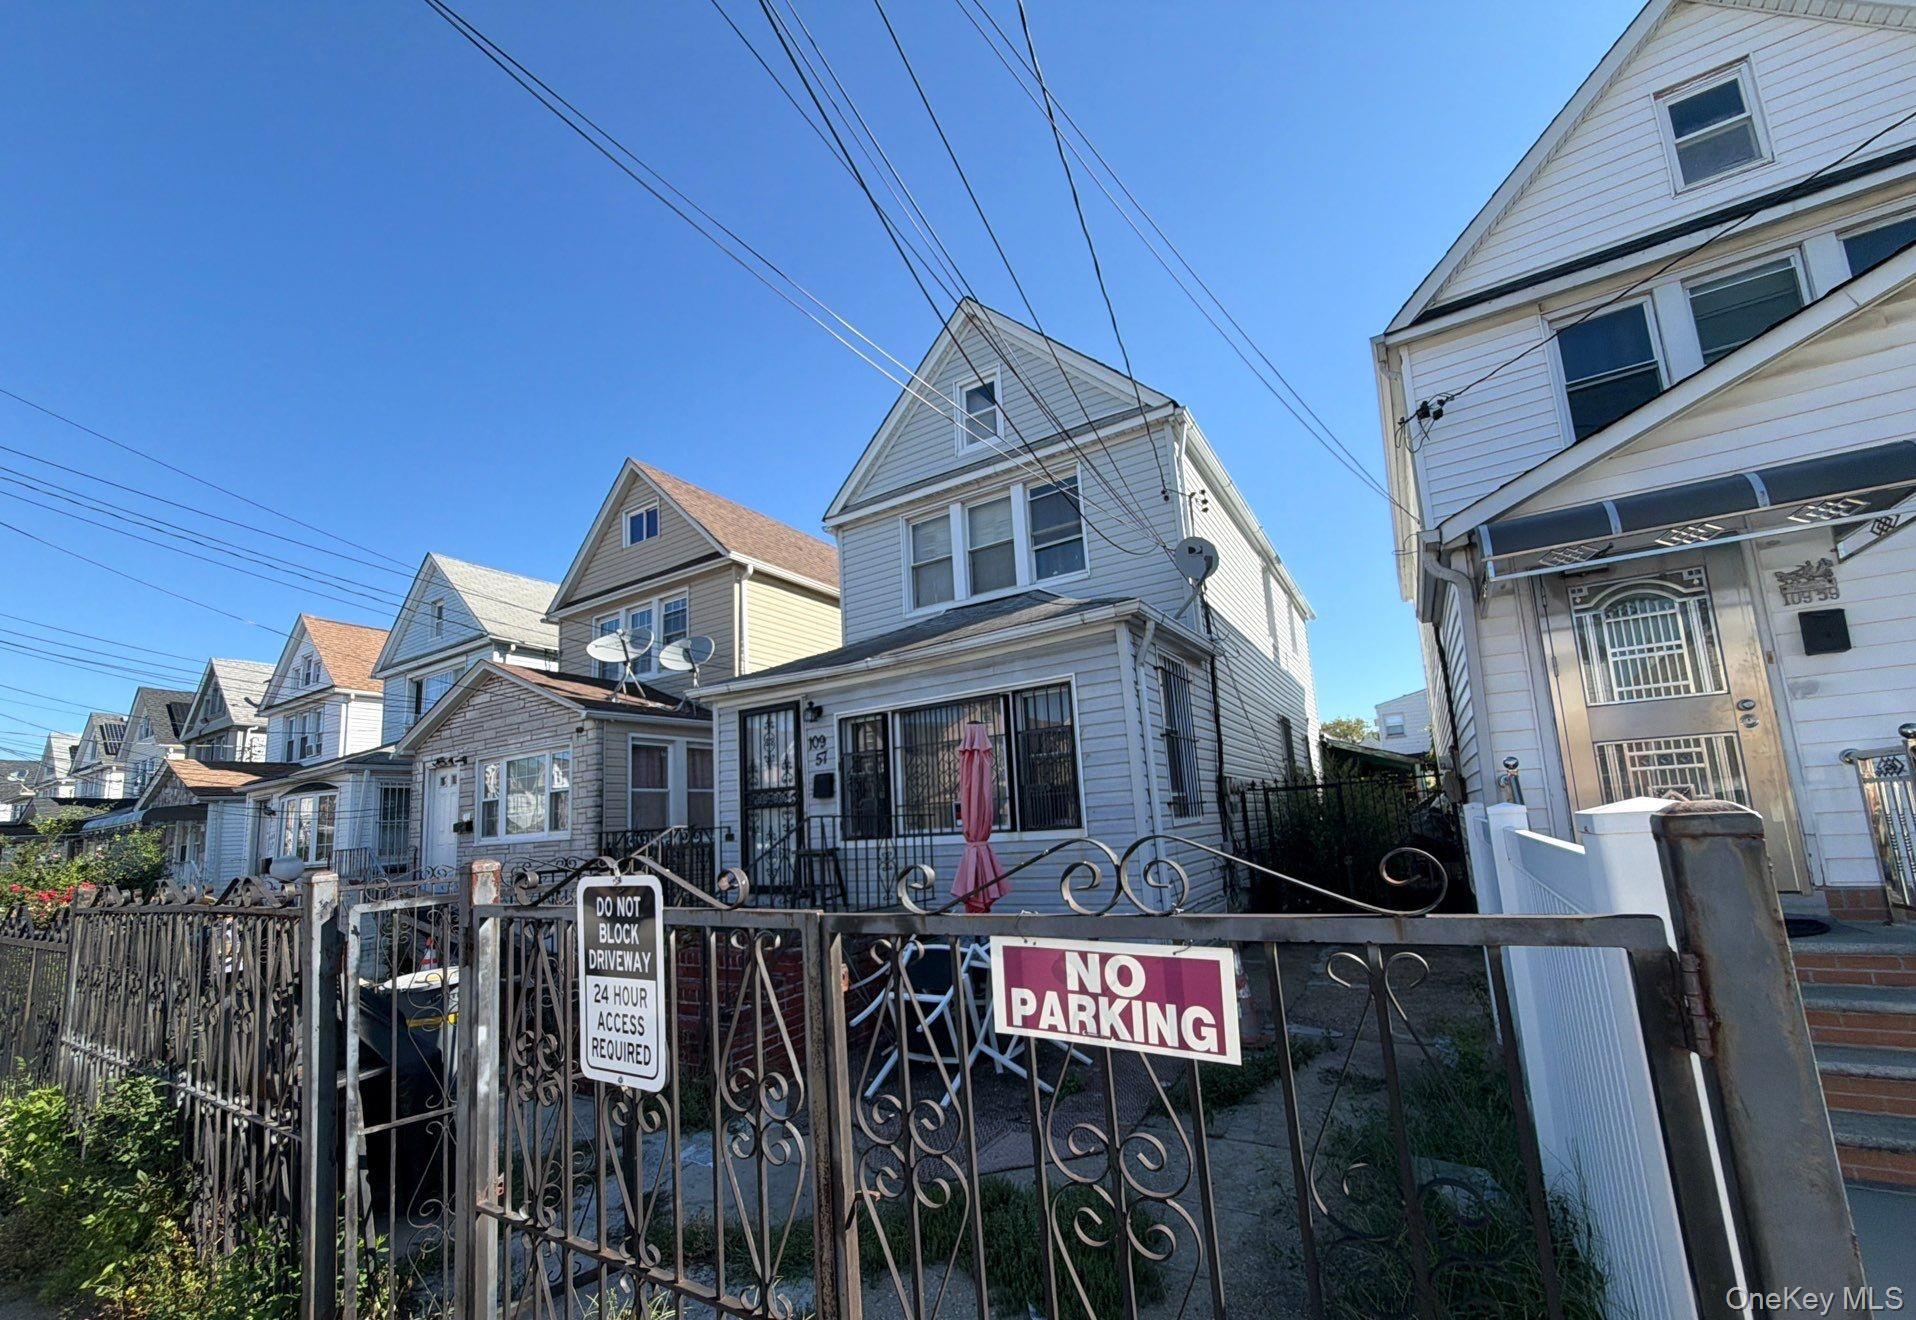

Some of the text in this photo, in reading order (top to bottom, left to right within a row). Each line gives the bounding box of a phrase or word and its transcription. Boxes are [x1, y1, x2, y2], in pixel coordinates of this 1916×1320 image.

[807, 734, 827, 751] 109
[815, 750, 828, 766] 57
[596, 896, 641, 918] DO NOT
[599, 922, 639, 945] BLOCK
[588, 949, 651, 973] DRIVEWAY
[1065, 951, 1146, 998] NO
[593, 983, 648, 1009] 24 HOUR
[597, 1011, 645, 1036] ACCESS
[1010, 987, 1219, 1053] PARKING
[591, 1037, 651, 1066] REQUIRED
